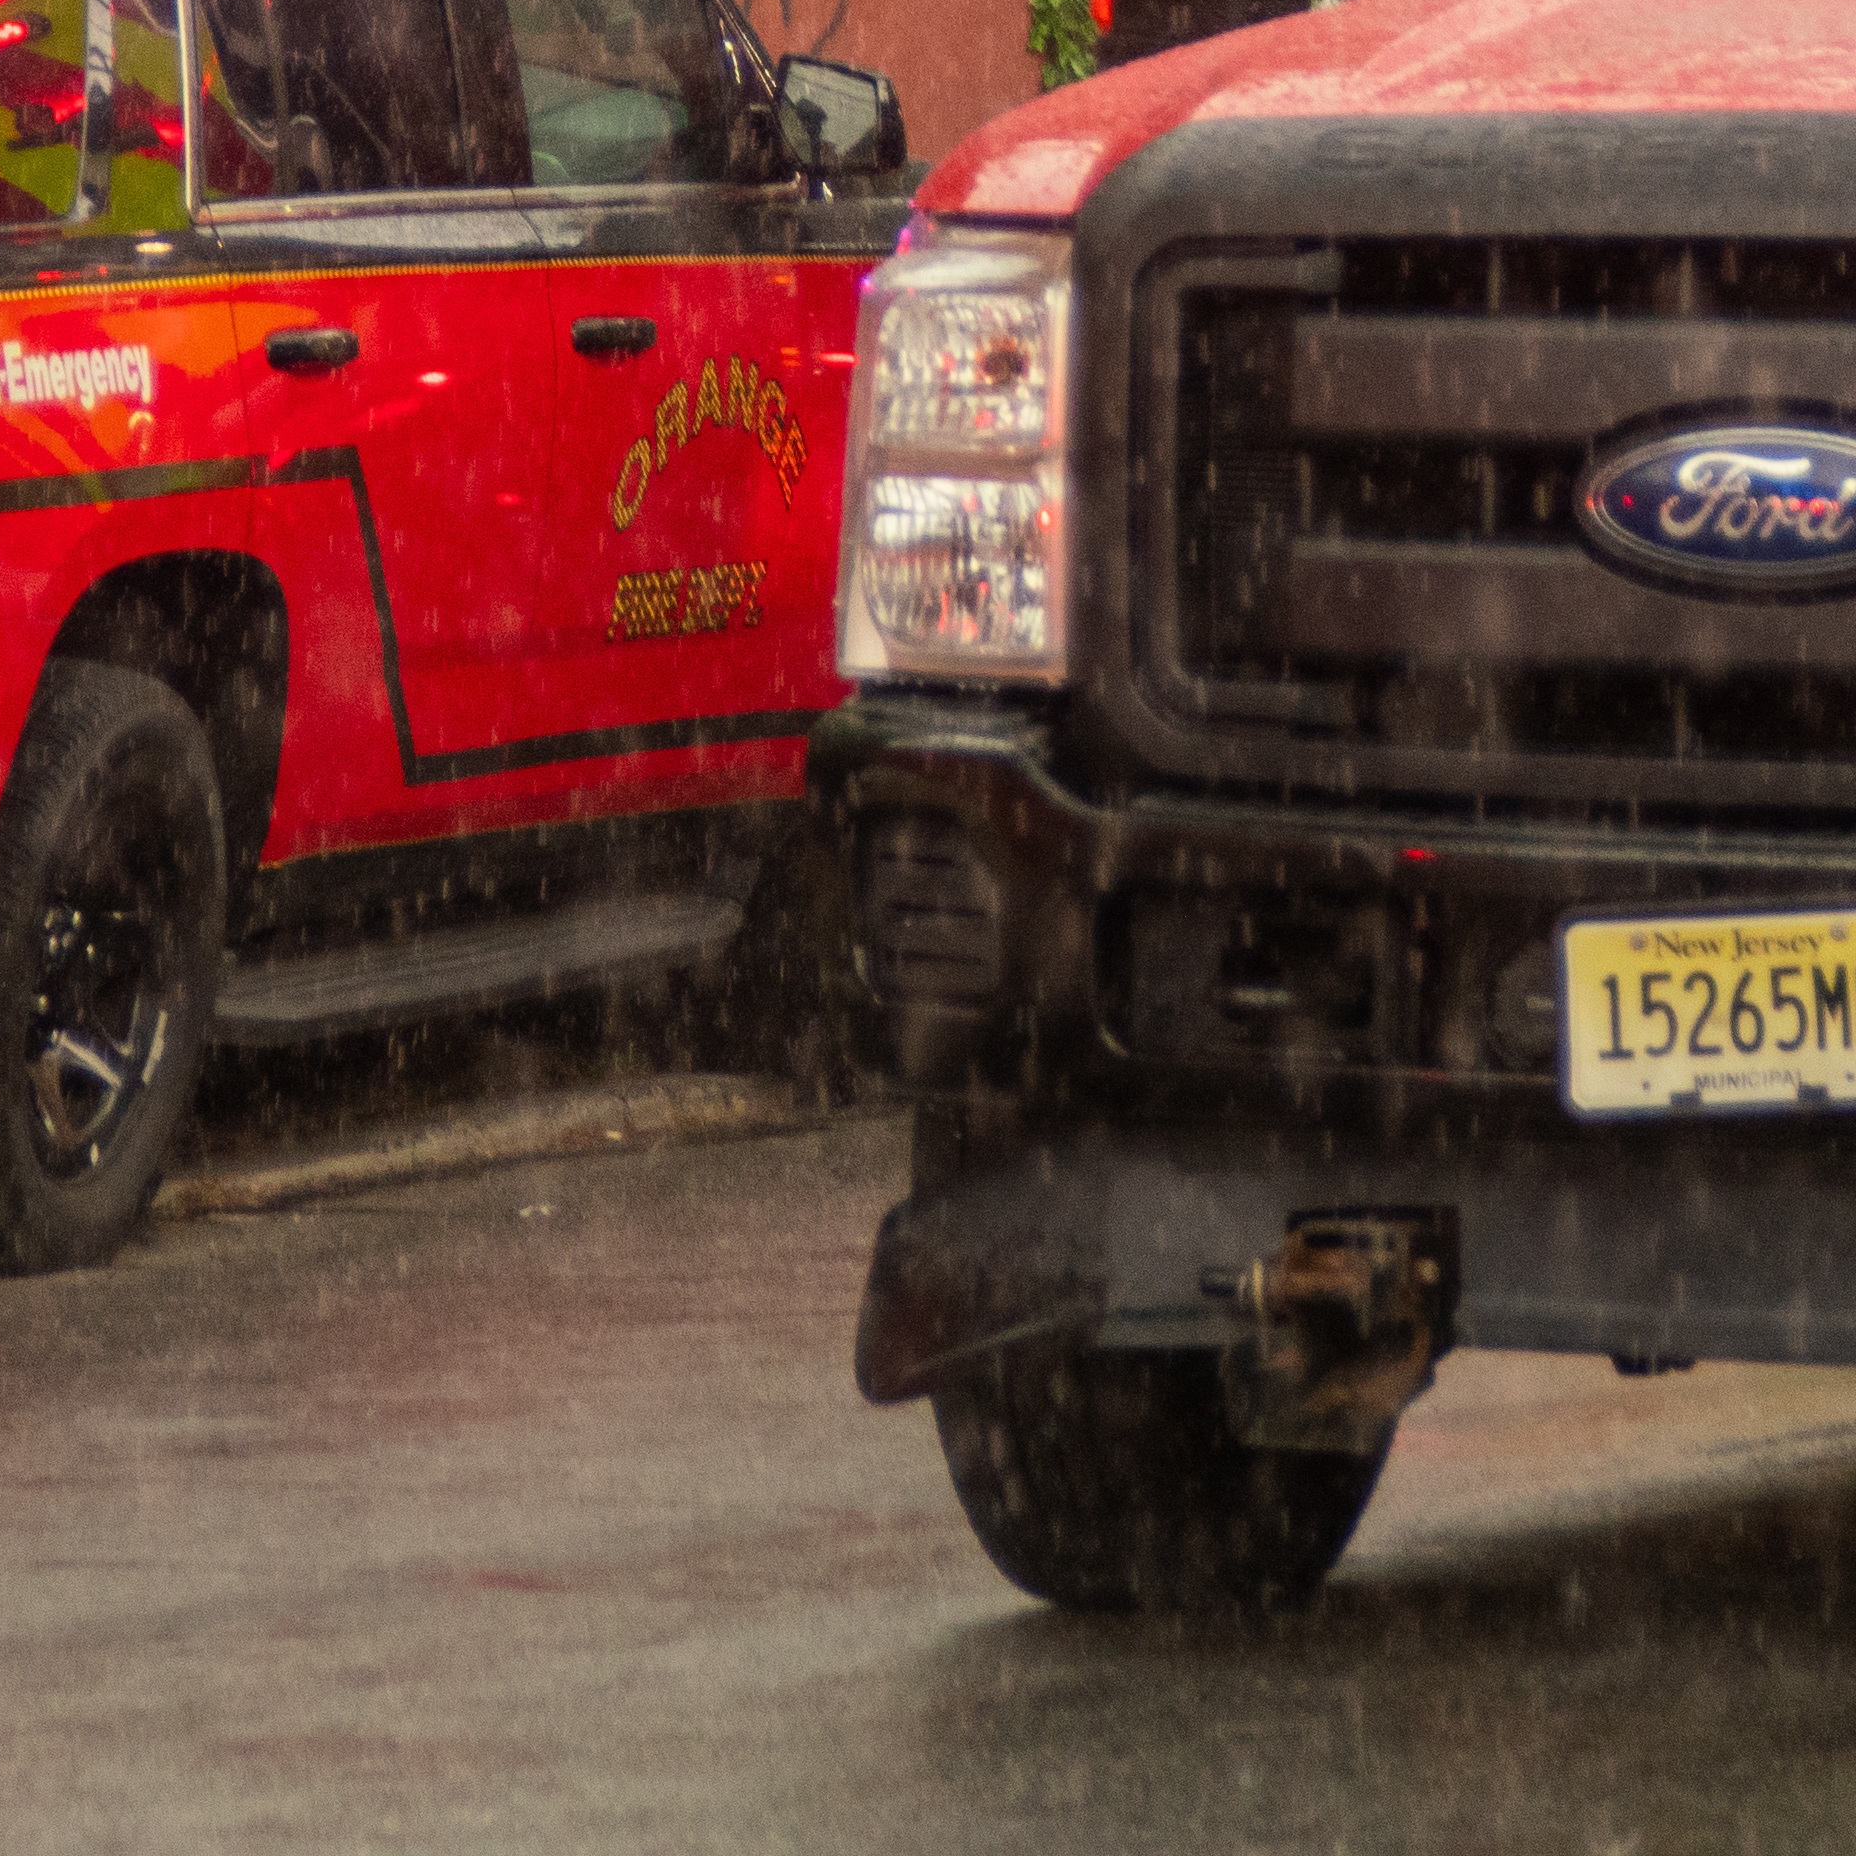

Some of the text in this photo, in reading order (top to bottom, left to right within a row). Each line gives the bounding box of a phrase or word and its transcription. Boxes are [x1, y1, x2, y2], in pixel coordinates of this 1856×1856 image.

[611, 353, 809, 533] ORANGE
[603, 566, 686, 643] FIRE
[1652, 927, 1824, 962] New Jersey
